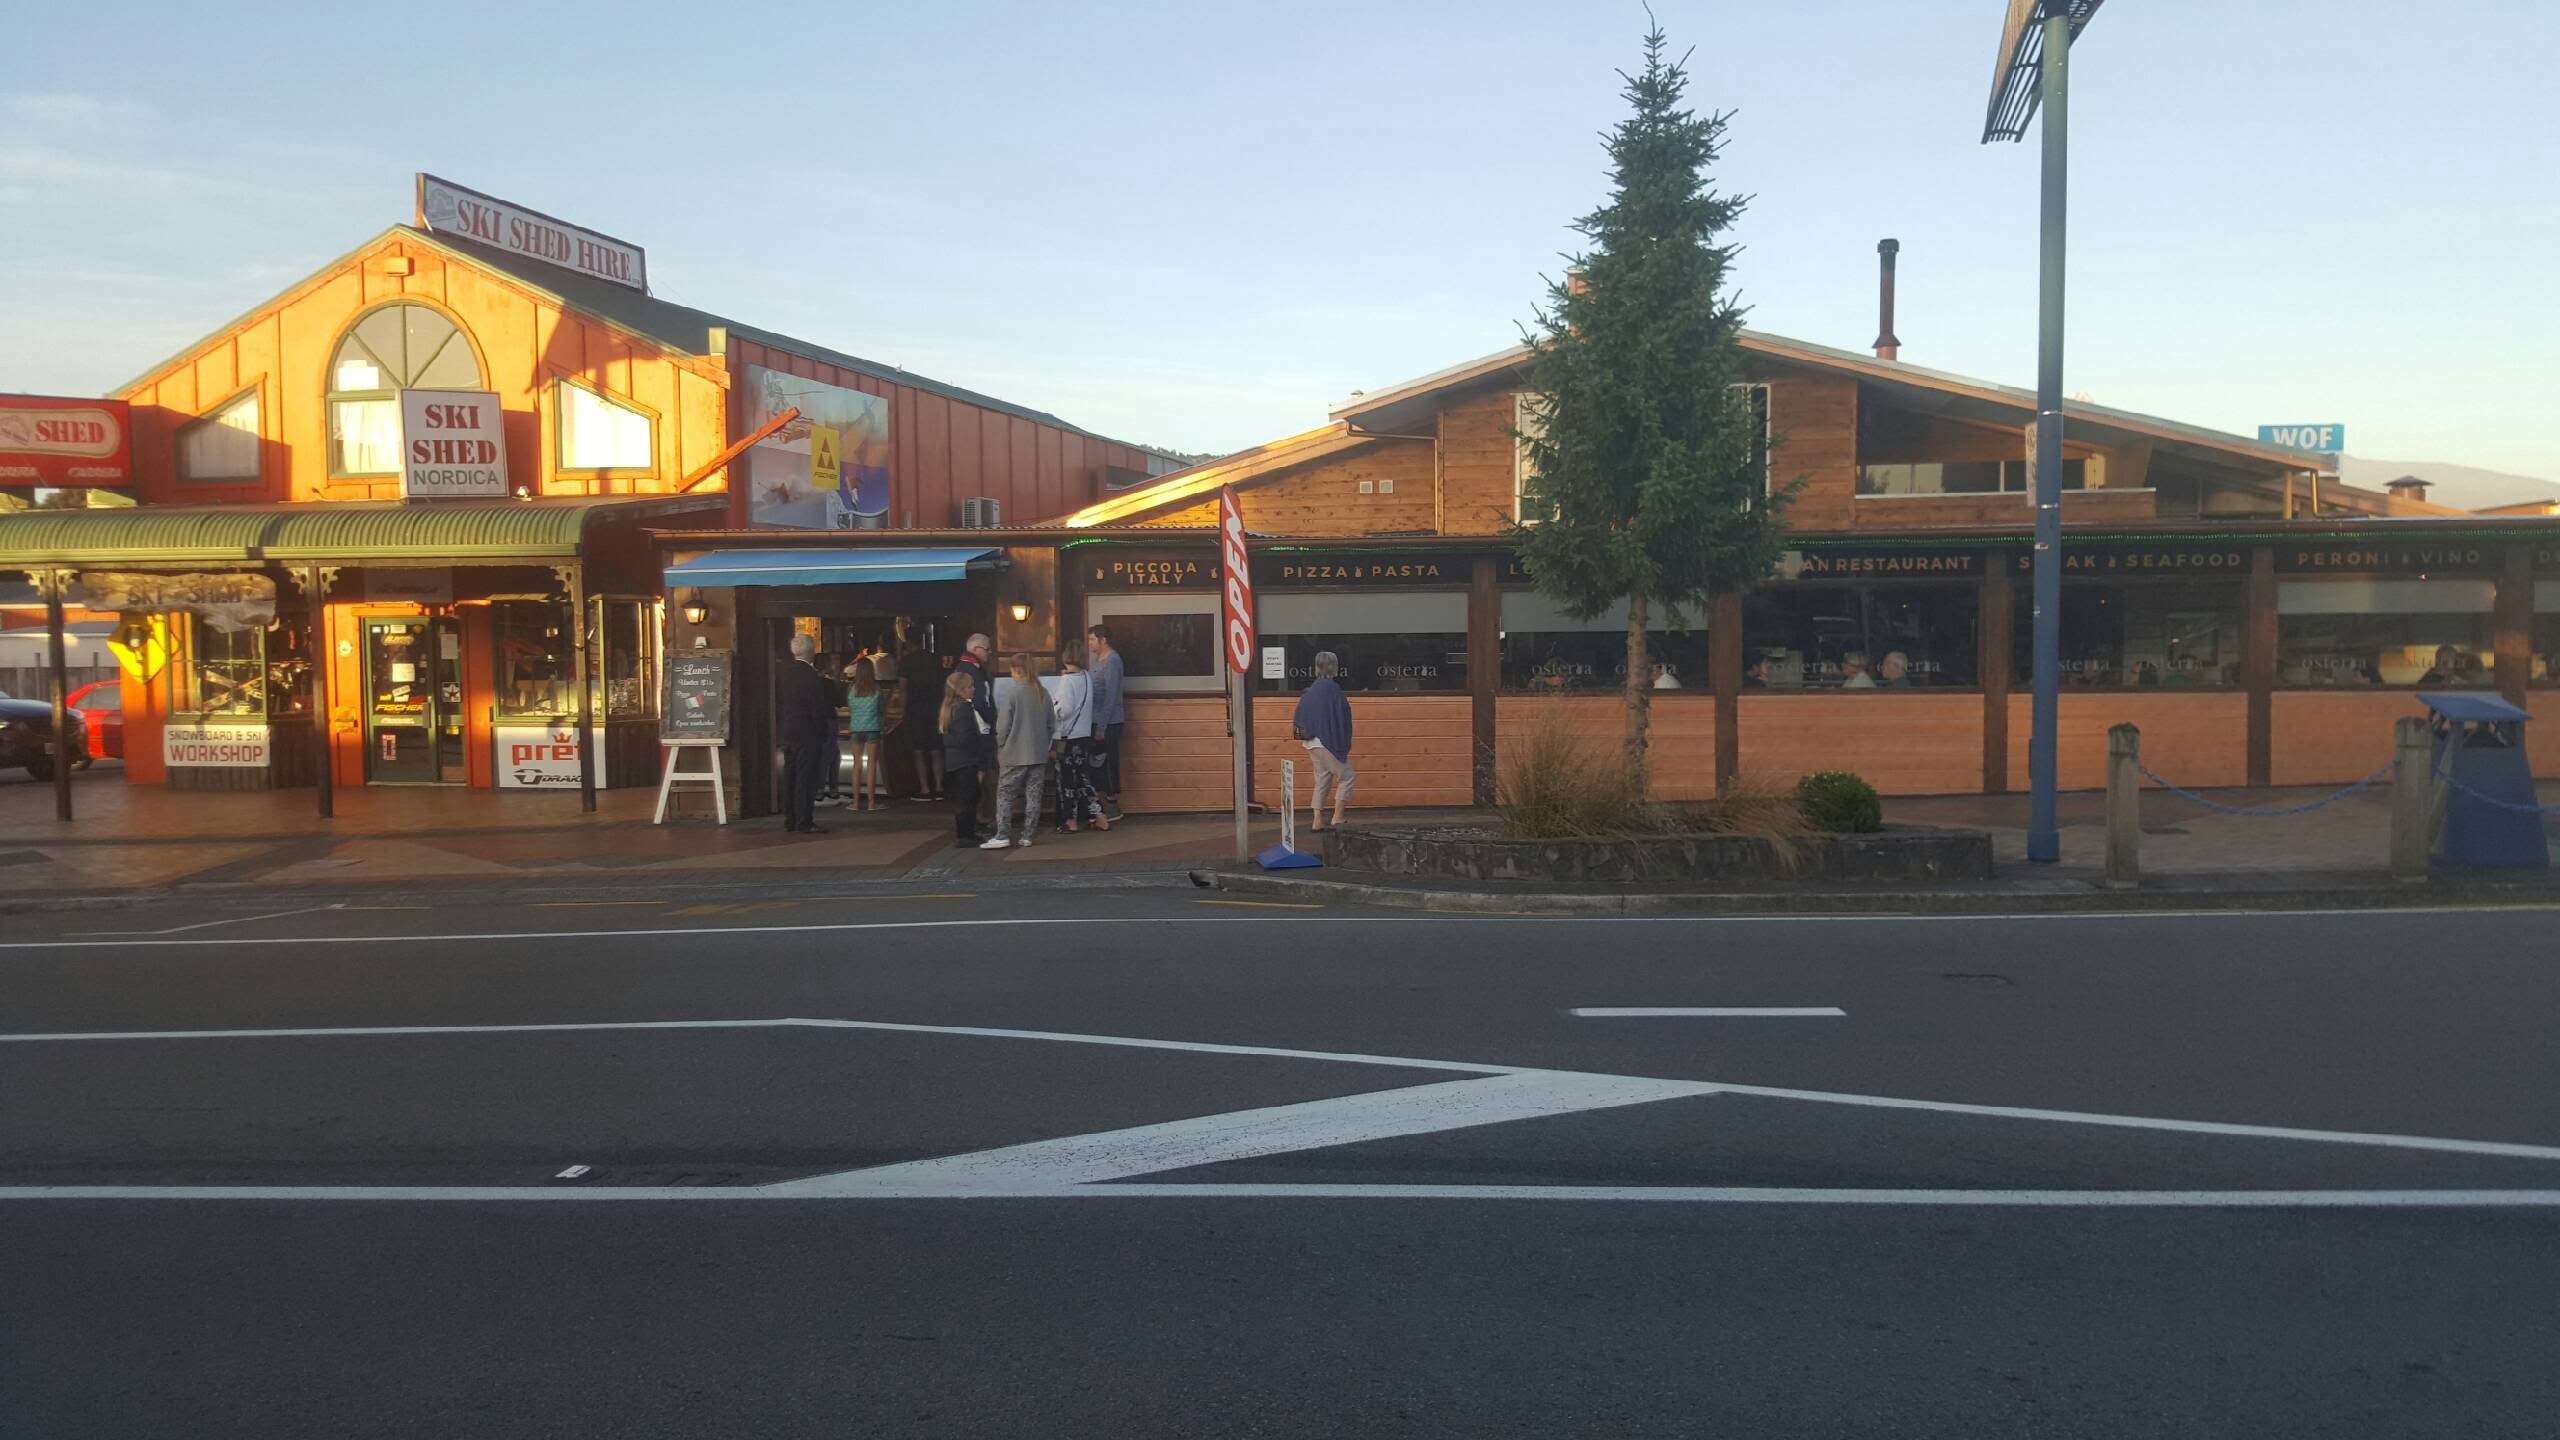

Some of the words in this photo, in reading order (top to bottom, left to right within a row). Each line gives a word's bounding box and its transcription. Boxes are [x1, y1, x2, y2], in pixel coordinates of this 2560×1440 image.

[457, 200, 502, 243] SKI
[509, 217, 571, 263] SHED
[577, 238, 632, 282] HIRE
[425, 404, 480, 429] SKI
[36, 420, 105, 443] SHED
[2272, 427, 2333, 449] WOF
[413, 439, 497, 465] SHED
[414, 470, 499, 485] NORDICA
[1836, 556, 1971, 572] RESTAURANT
[2019, 555, 2096, 569] SAK
[2127, 553, 2241, 568] SEAFOOD
[2298, 551, 2390, 566] PERONI
[2421, 550, 2480, 564] VINO
[1113, 562, 1197, 574] PICCOLA
[1283, 566, 1348, 578] PIZZA
[1372, 565, 1440, 577] PASTA
[1129, 573, 1185, 585] ITALY
[1224, 492, 1250, 670] OPEN
[682, 664, 711, 676] Lunch
[1289, 664, 1348, 678] osta
[1876, 660, 1941, 673] oeria
[2057, 658, 2110, 672] steria
[375, 704, 424, 712] FISCHER
[168, 730, 233, 741] SNOWBOARD
[247, 730, 262, 741] SKI
[169, 745, 263, 762] WORKSHOP
[542, 774, 582, 783] DRAK
